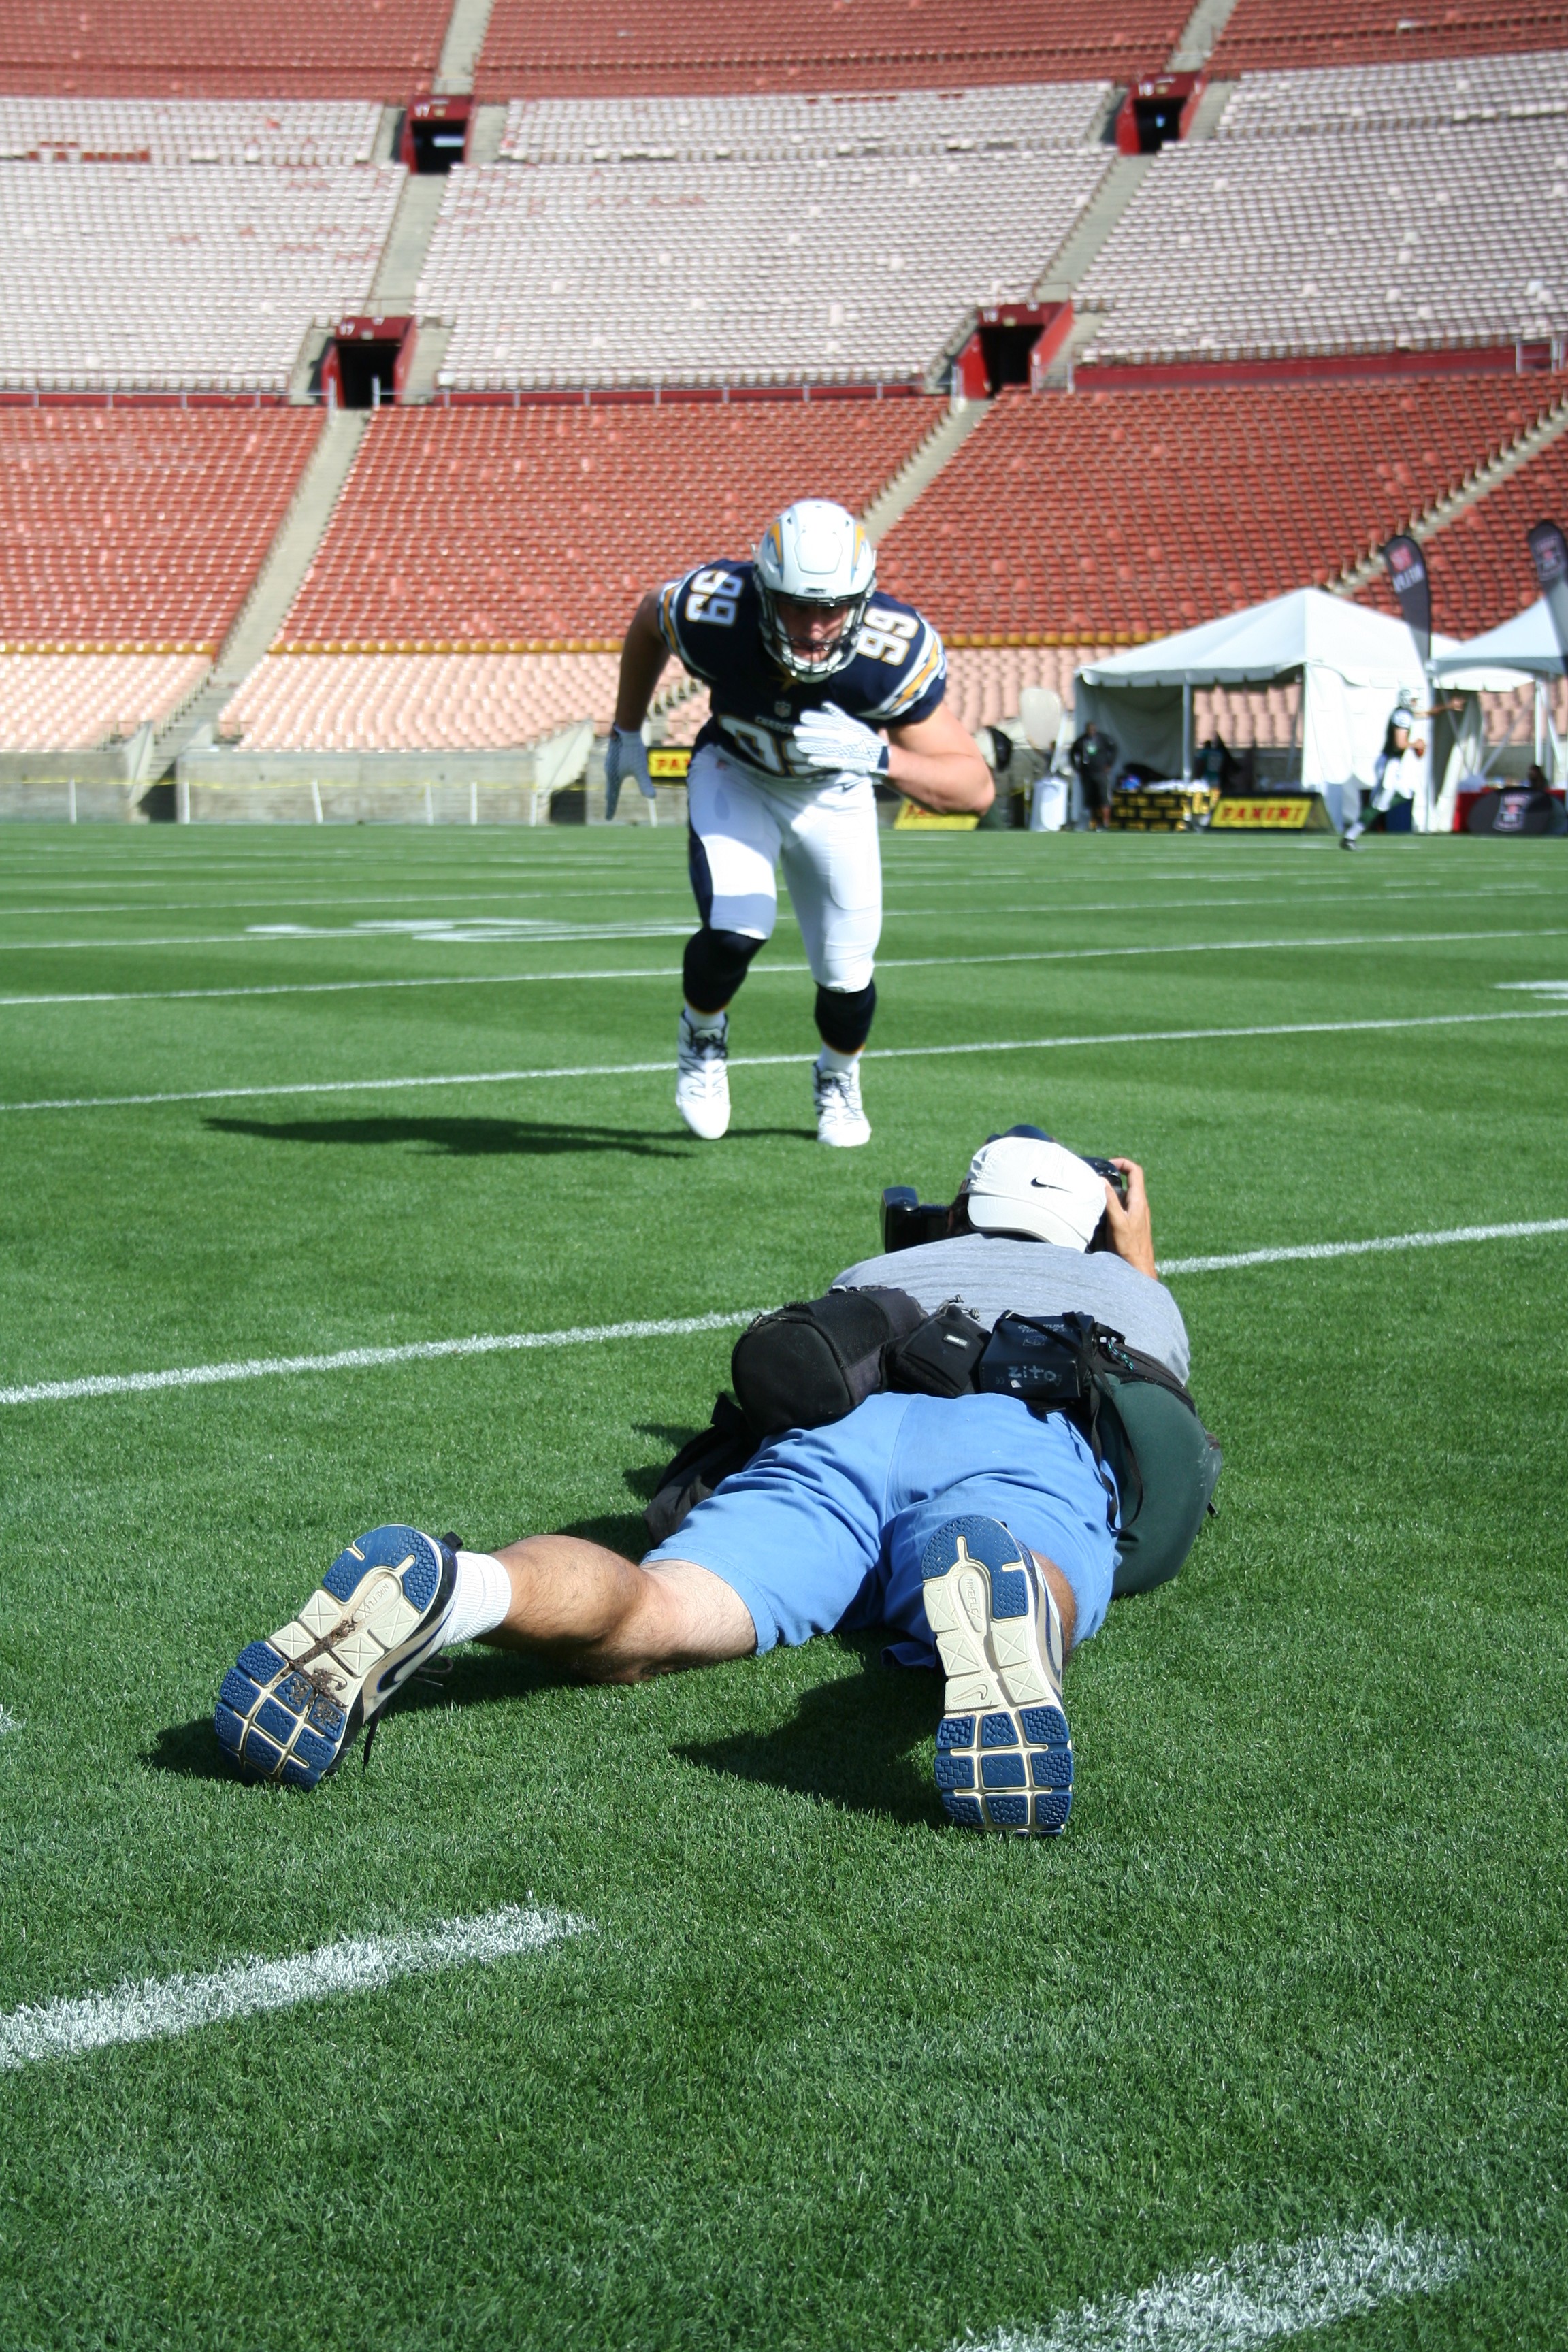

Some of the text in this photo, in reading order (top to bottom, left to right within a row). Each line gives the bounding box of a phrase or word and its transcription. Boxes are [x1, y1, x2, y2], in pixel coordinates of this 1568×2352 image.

[685, 569, 744, 626] 99
[855, 607, 919, 666] 99
[755, 715, 795, 734] CHARGE
[1220, 807, 1304, 822] PANINI
